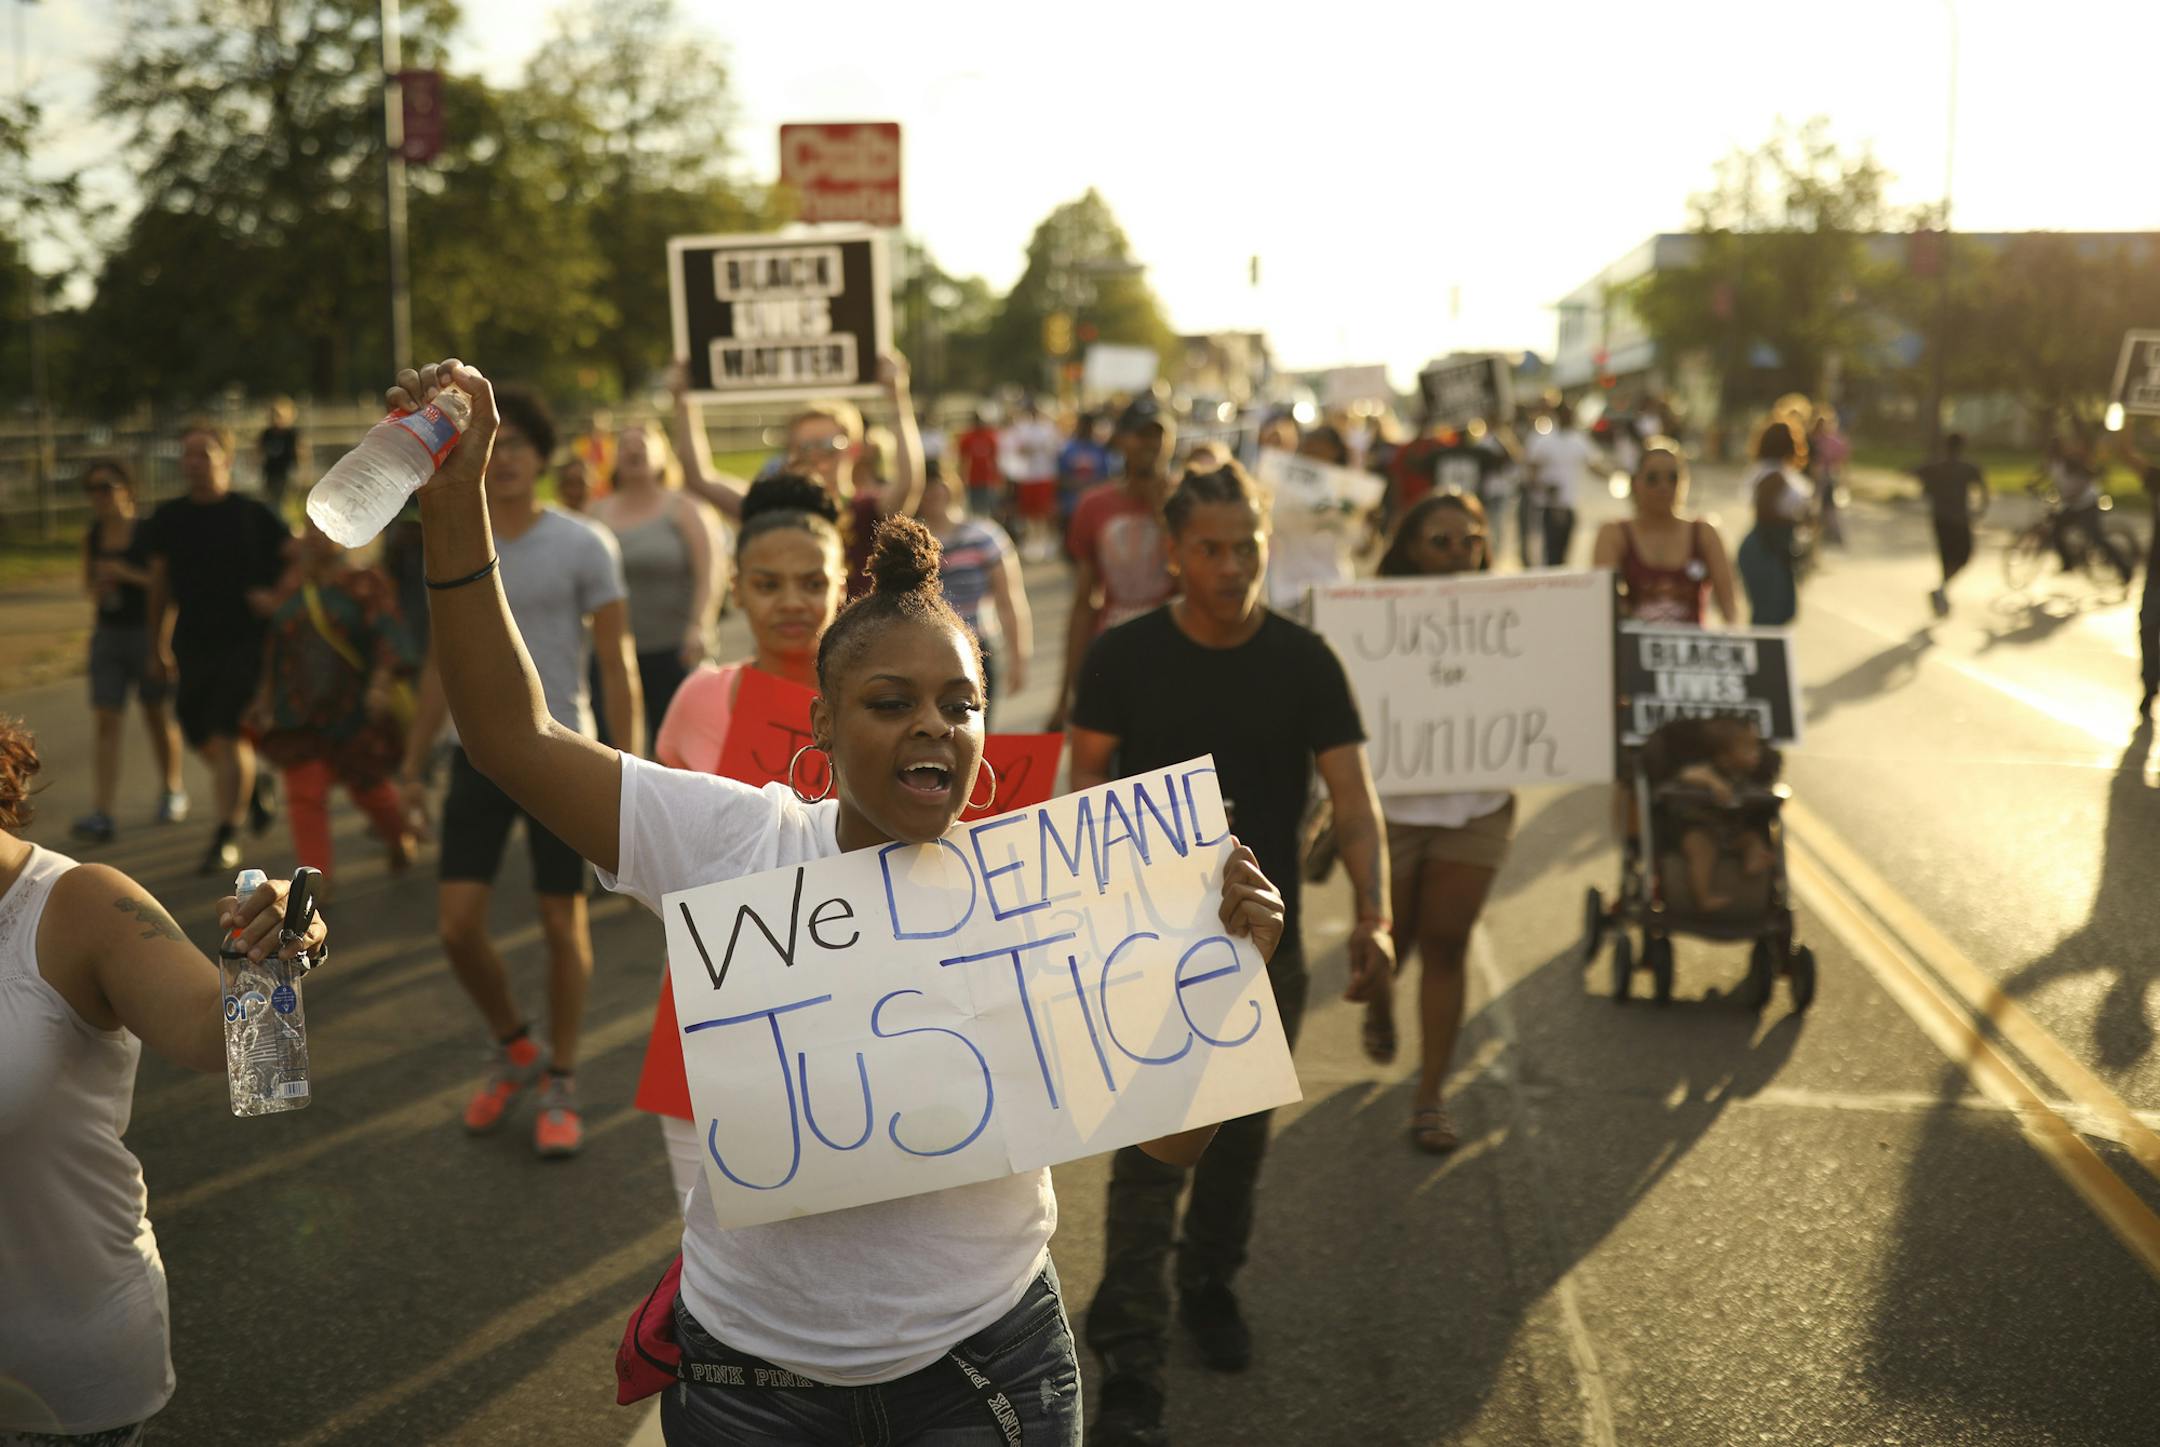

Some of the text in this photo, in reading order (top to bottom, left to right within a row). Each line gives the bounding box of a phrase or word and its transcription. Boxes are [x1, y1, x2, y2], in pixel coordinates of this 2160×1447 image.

[1352, 597, 1525, 662] Justice
[680, 768, 1232, 990] We DEMAND
[691, 1362, 745, 1386] PINK
